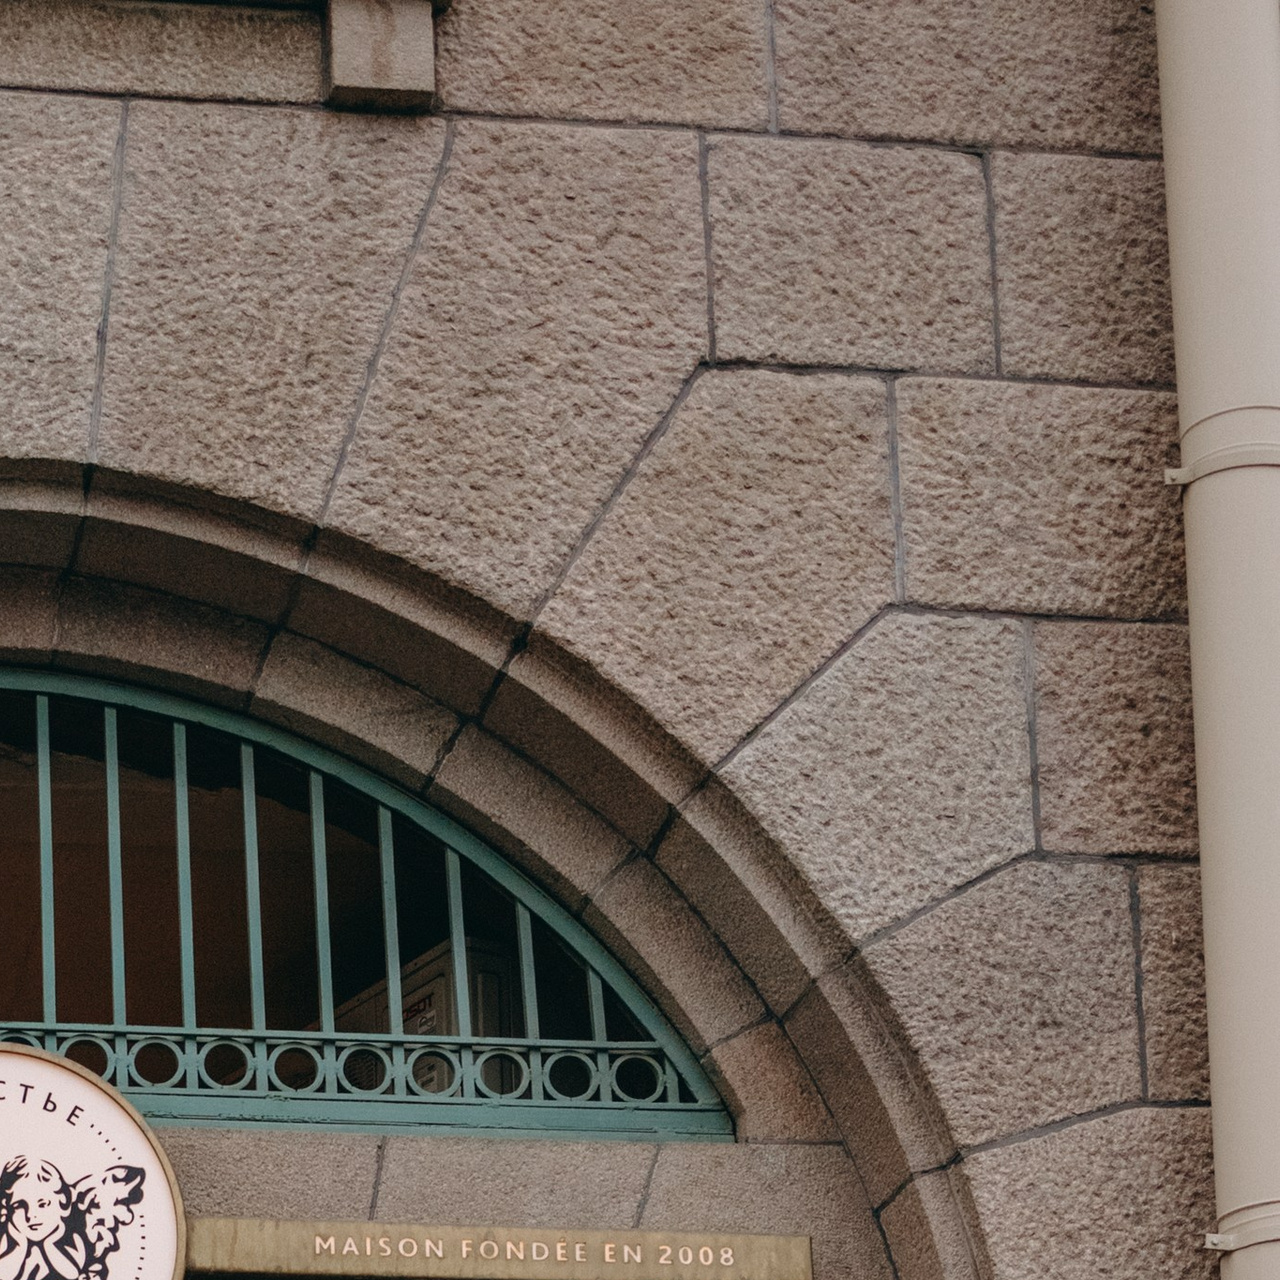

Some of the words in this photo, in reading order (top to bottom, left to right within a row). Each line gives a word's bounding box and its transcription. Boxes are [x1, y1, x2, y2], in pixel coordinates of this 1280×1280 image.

[314, 1235, 444, 1259] MAISON
[460, 1237, 588, 1262] FONDÉE
[604, 1243, 643, 1264] EN
[658, 1245, 735, 1266] 2008
